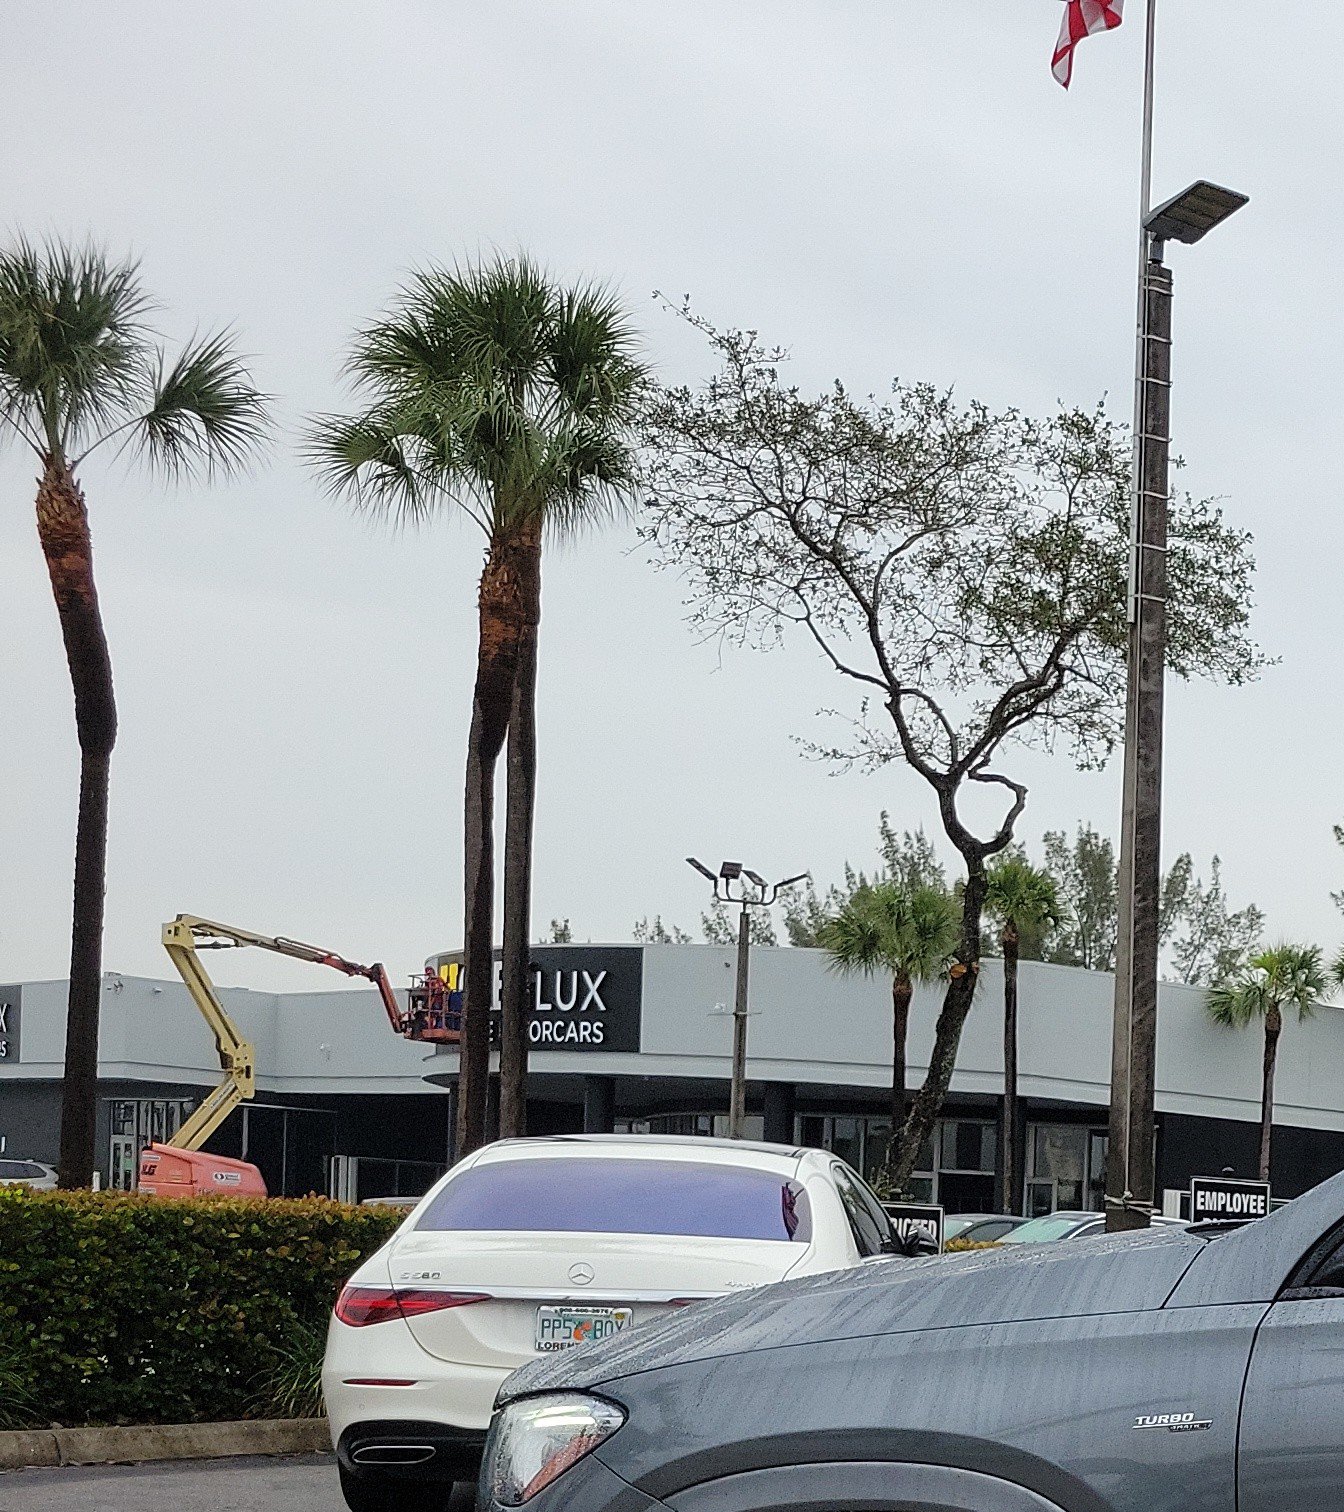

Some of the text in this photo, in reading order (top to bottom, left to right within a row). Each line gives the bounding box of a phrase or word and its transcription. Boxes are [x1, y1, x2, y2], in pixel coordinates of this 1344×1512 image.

[535, 970, 607, 1011] LUX
[1196, 1190, 1266, 1215] EMPLOYEE
[1134, 1412, 1195, 1425] TURBO
